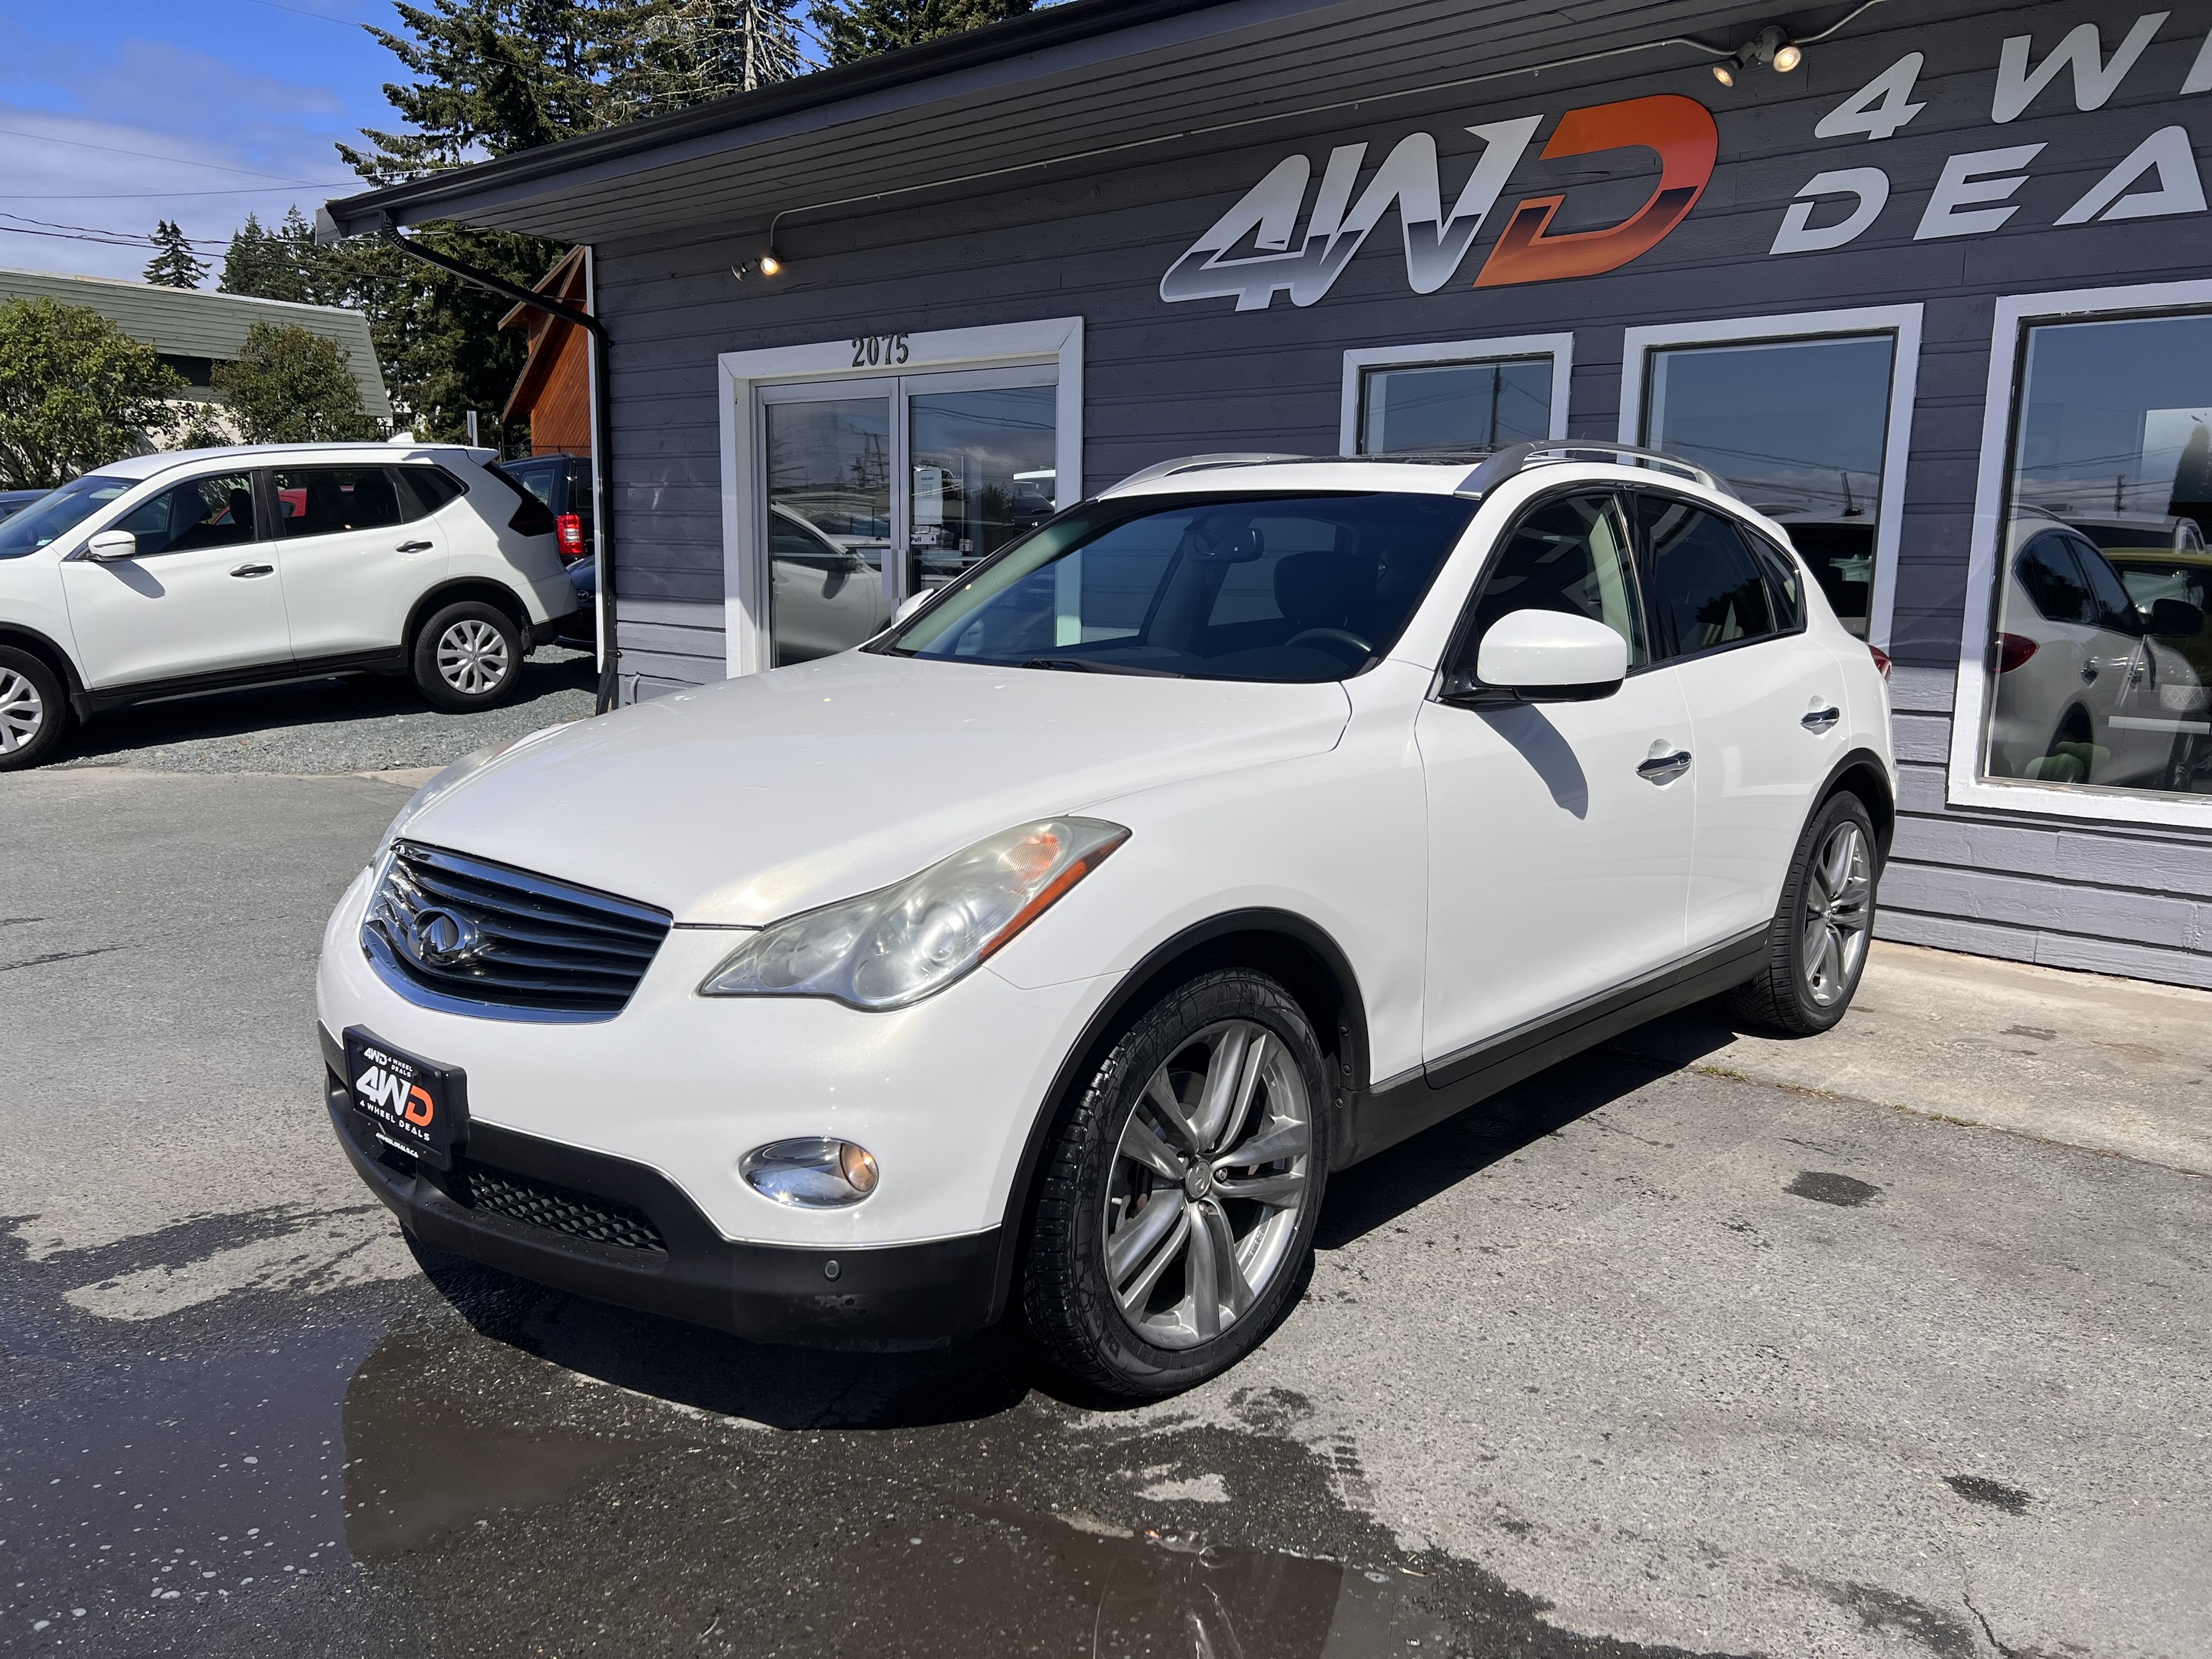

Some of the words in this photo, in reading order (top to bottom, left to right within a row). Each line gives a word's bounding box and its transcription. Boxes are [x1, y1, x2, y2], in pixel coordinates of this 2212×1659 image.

[1814, 51, 1928, 140] 4
[1159, 94, 1718, 311] 4WD
[851, 333, 909, 367] 2075
[364, 1047, 387, 1066] 4WD
[391, 1065, 412, 1078] DEALS
[393, 1058, 412, 1072] WHEEL
[356, 1065, 434, 1127] 4WD
[367, 1102, 396, 1124] WHEEL
[399, 1119, 430, 1141] DEALS
